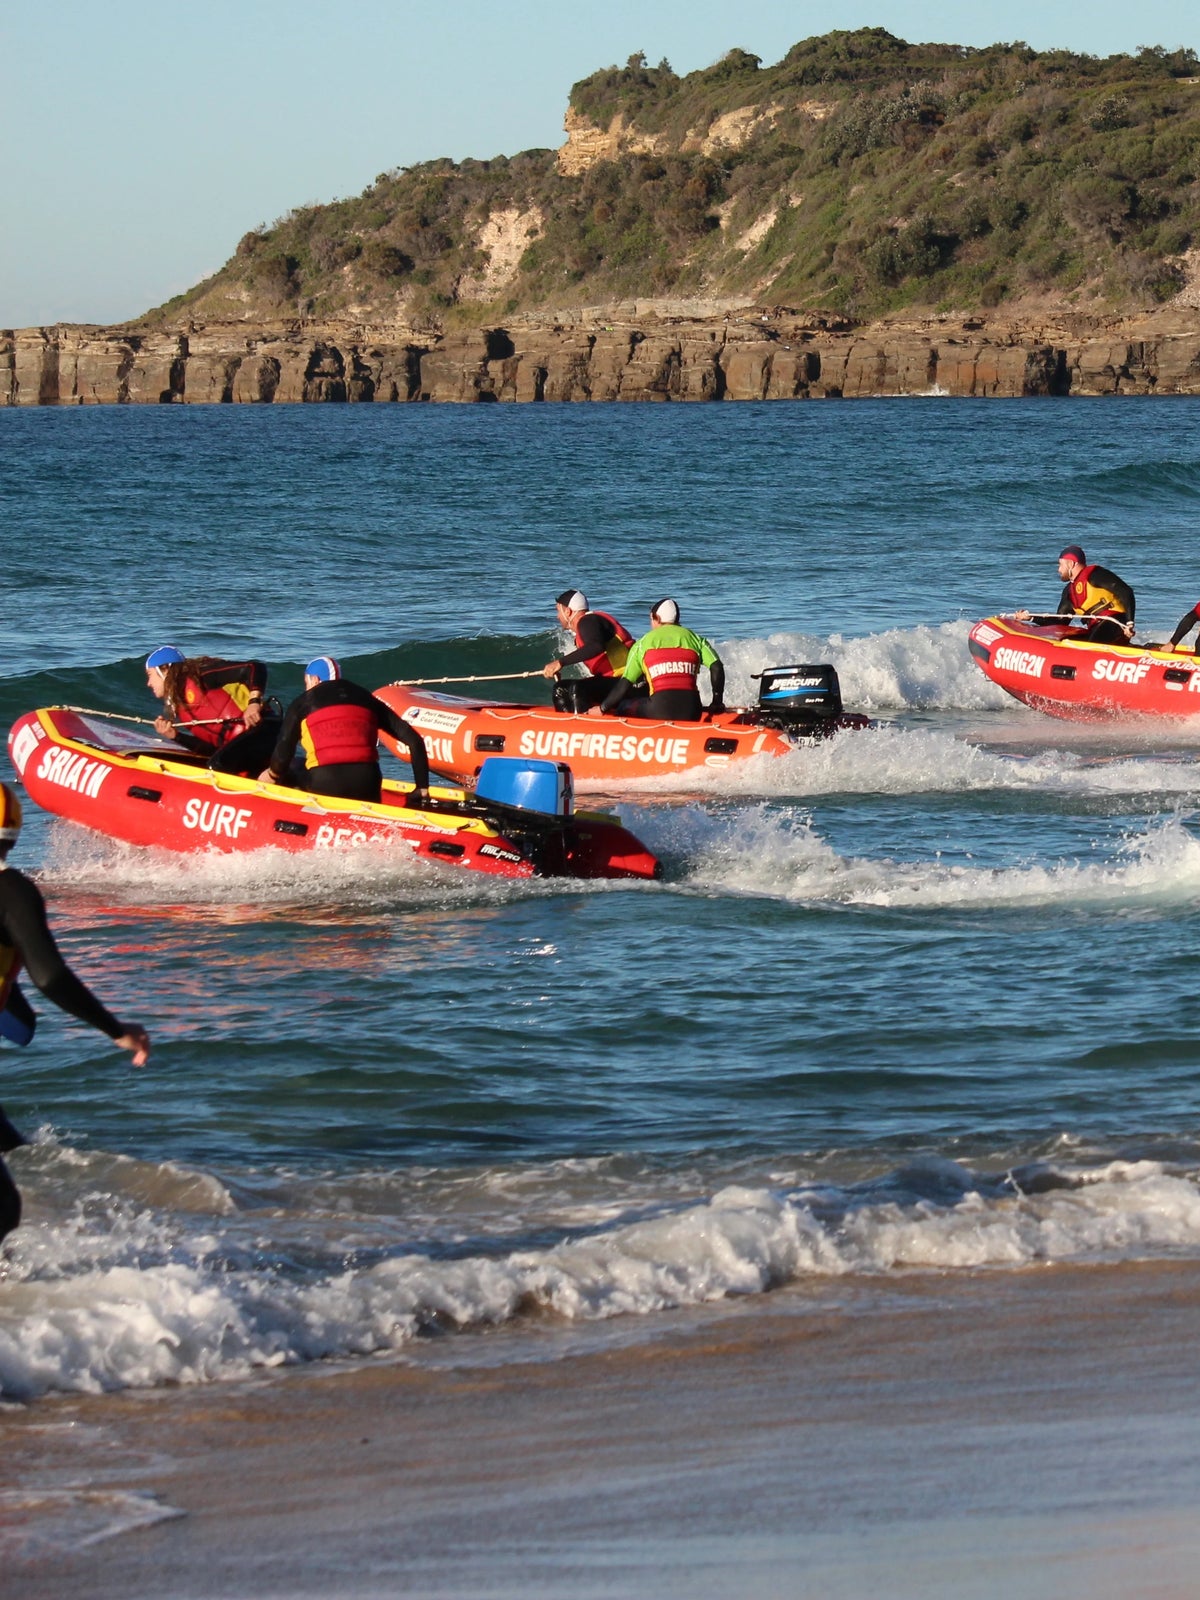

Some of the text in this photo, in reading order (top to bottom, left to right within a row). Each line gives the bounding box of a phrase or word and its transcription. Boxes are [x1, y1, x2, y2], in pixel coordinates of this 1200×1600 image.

[649, 661, 696, 679] NEWCASTLE
[994, 647, 1046, 678] SRHG2N
[1092, 659, 1150, 684] SURF
[769, 677, 823, 690] MERCURY
[589, 734, 690, 764] RESCUE
[37, 746, 112, 798] SRIA1N
[182, 798, 252, 838] SURF
